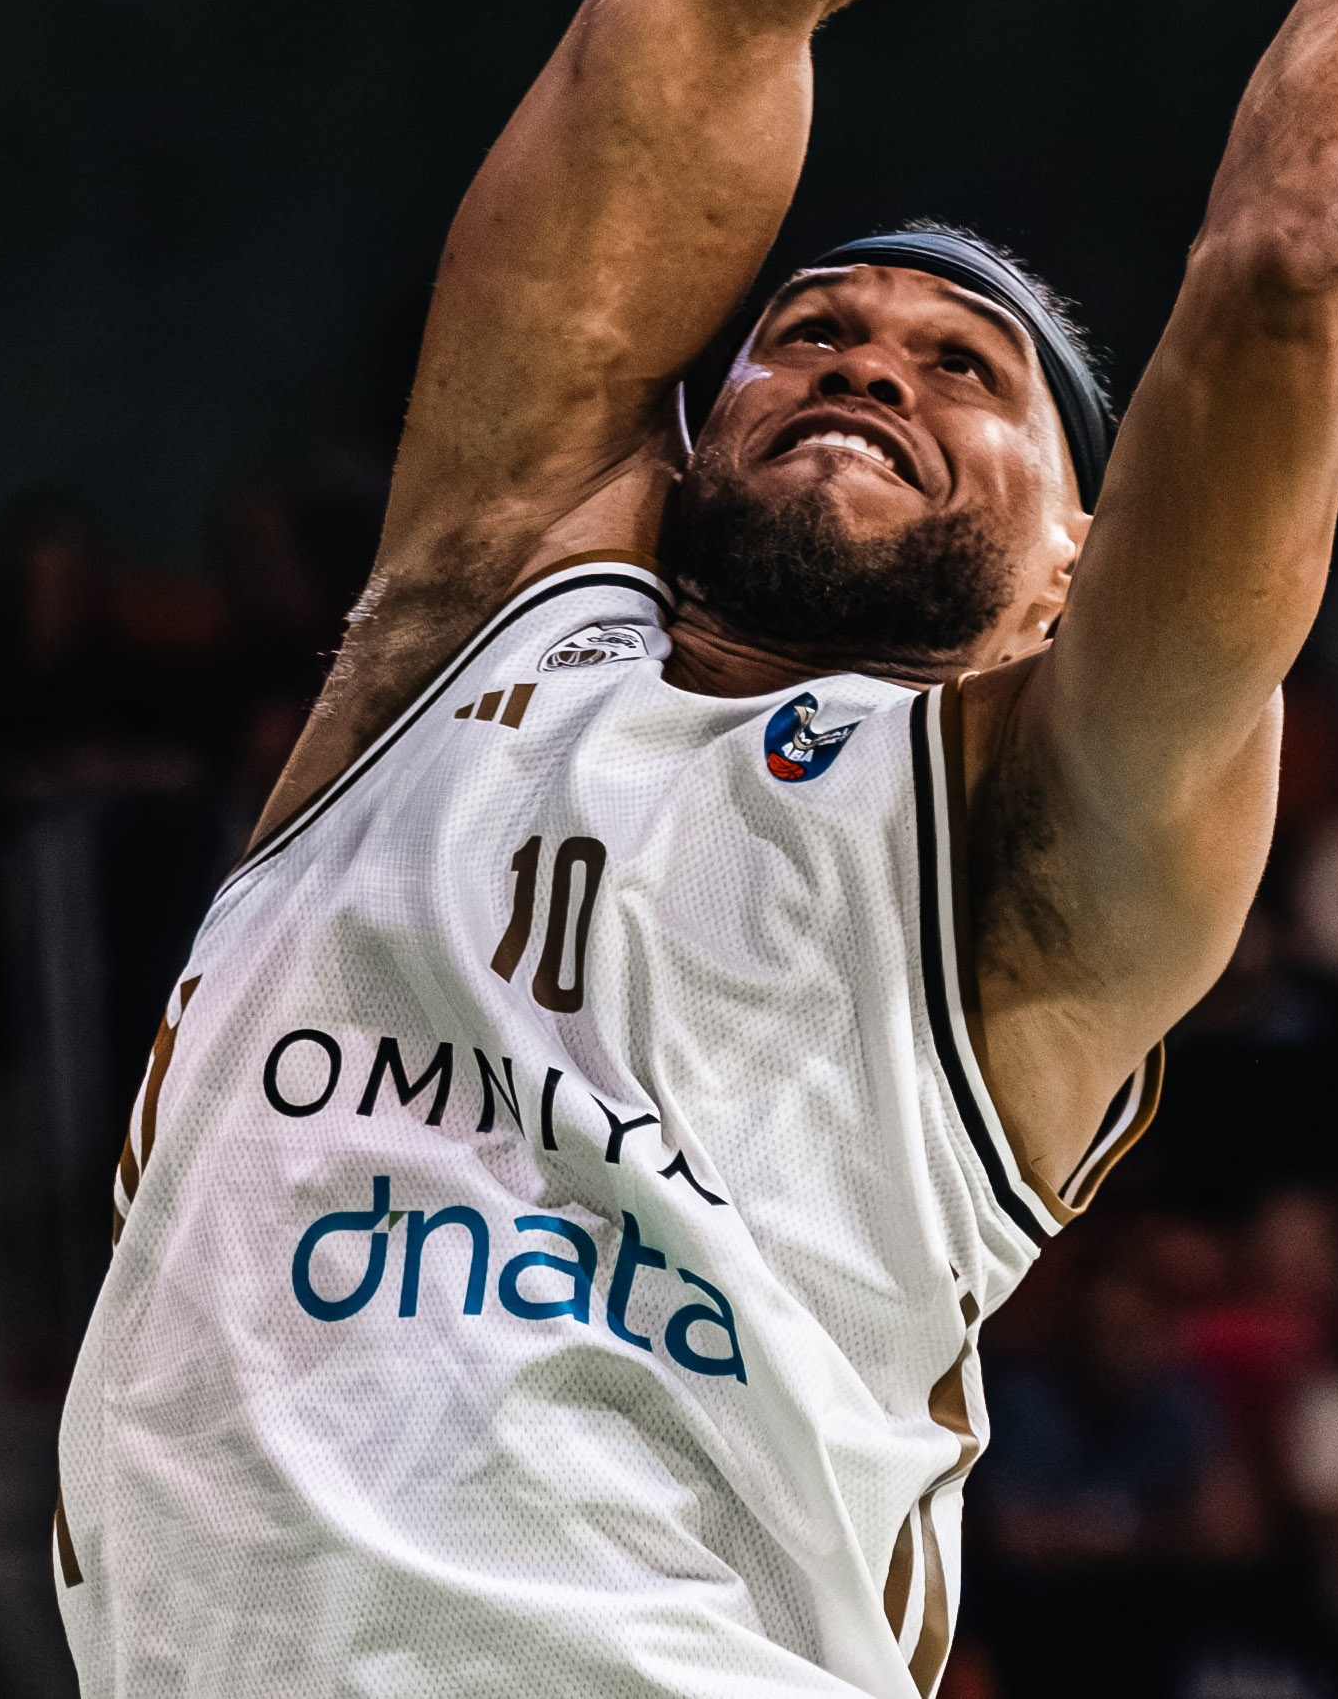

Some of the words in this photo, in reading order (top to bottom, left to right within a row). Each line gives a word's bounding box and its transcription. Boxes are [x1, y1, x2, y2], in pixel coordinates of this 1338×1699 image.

[782, 741, 814, 762] ABA
[490, 835, 607, 1014] 10
[291, 1175, 748, 1386] dnata
